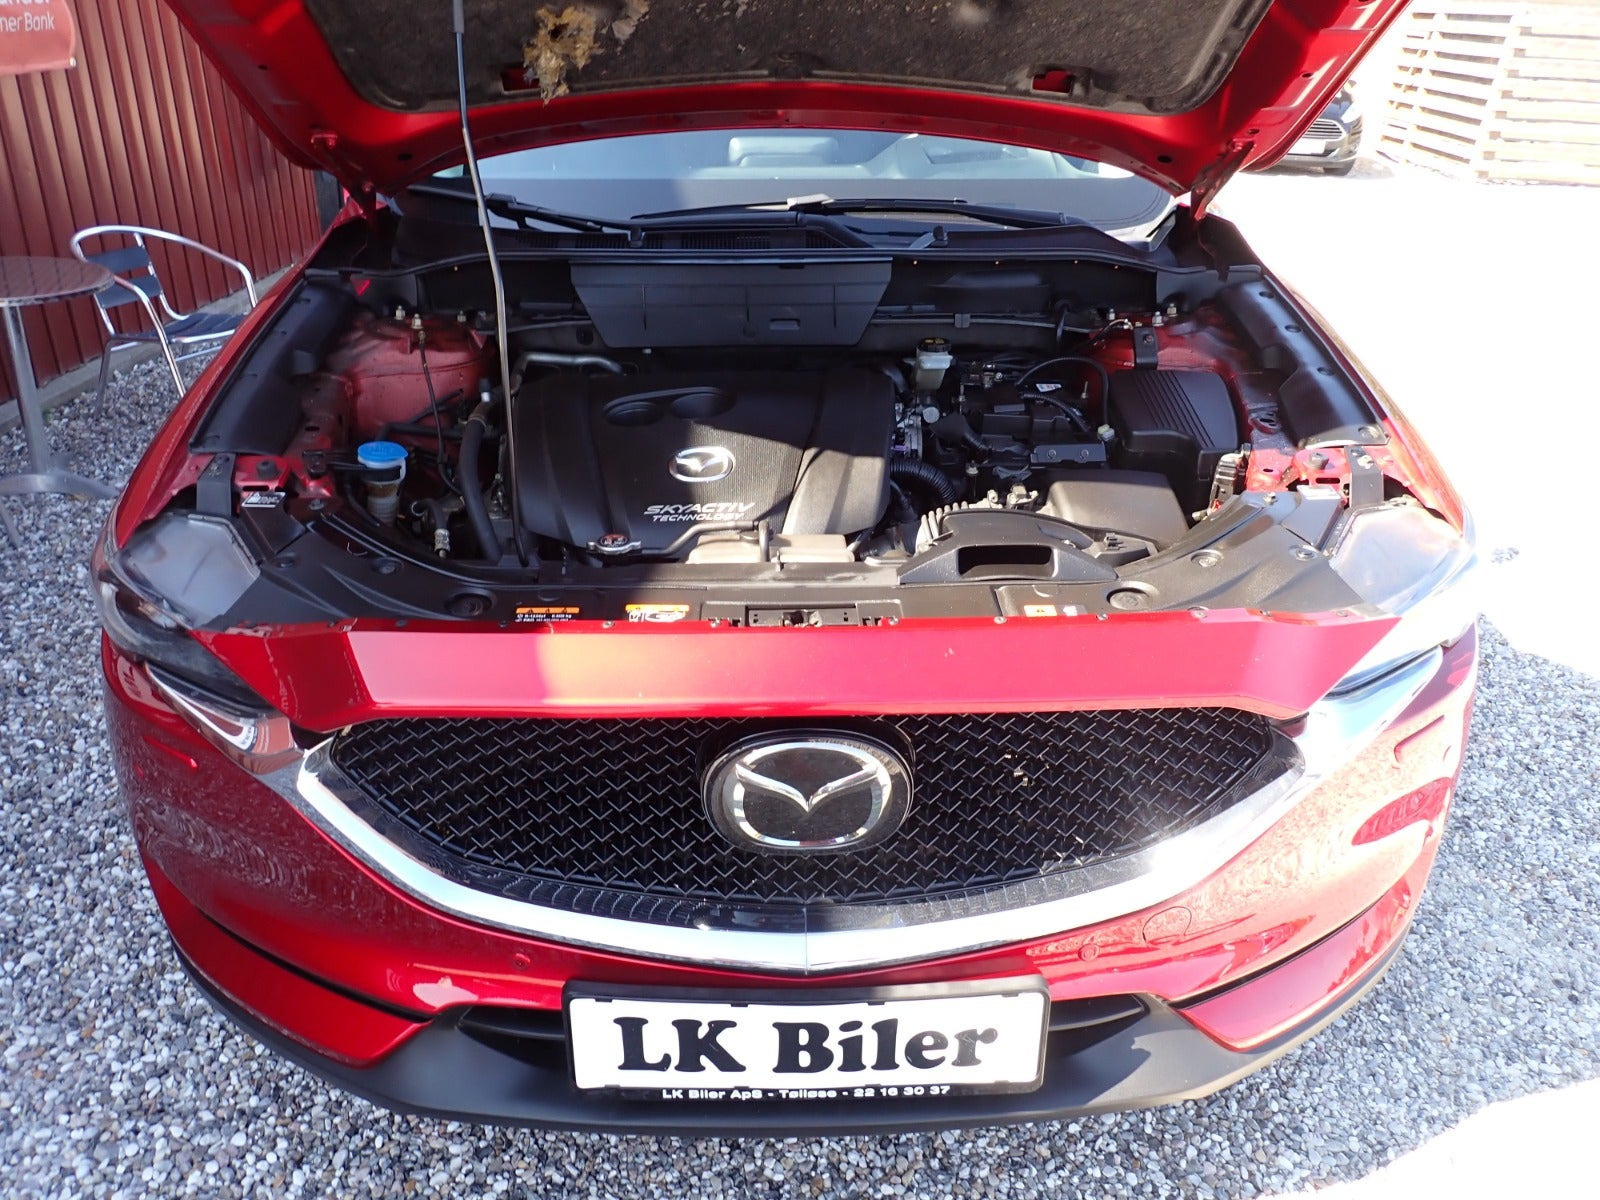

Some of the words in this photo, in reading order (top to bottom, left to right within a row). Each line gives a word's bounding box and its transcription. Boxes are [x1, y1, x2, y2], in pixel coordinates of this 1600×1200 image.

[24, 11, 55, 32] Bank
[644, 502, 755, 515] SKYACTIV
[653, 512, 745, 522] TECHNOLOGY
[613, 1017, 746, 1072] LK
[772, 1018, 998, 1073] Biler
[662, 1089, 684, 1099] LK
[688, 1089, 726, 1099] Biler
[730, 1089, 763, 1101] ApS
[853, 1087, 875, 1097] 22
[879, 1087, 899, 1097] 16
[903, 1086, 925, 1096] 30
[929, 1085, 951, 1095] 37
